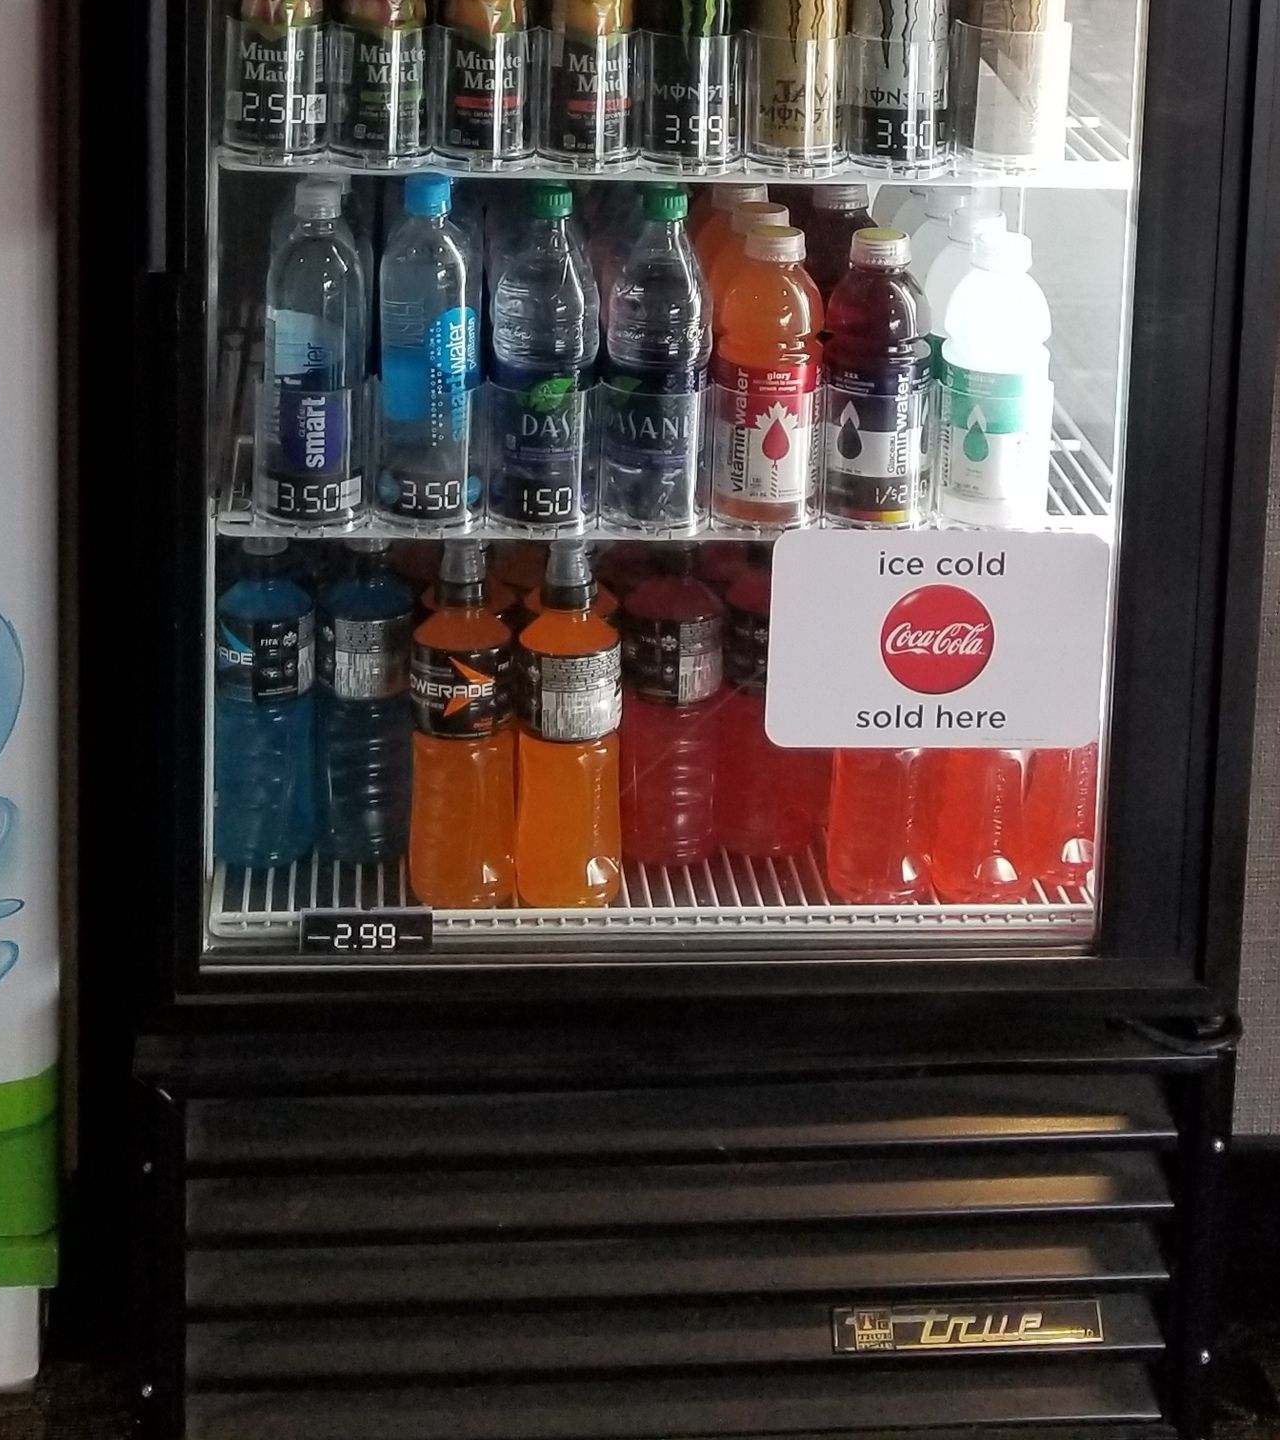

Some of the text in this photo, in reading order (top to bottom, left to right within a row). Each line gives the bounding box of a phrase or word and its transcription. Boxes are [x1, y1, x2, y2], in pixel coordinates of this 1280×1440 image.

[243, 92, 305, 124] 2.50
[767, 371, 791, 380] glory
[306, 396, 326, 468] smart
[732, 368, 749, 493] vitaminwater
[280, 483, 340, 513] 3.50
[402, 480, 461, 510] 3.50
[522, 487, 572, 516] 1.50
[878, 551, 1006, 577] ice cold
[886, 622, 990, 656] Coca-Cola
[855, 703, 1007, 730] sold here
[334, 924, 396, 949] 2.99
